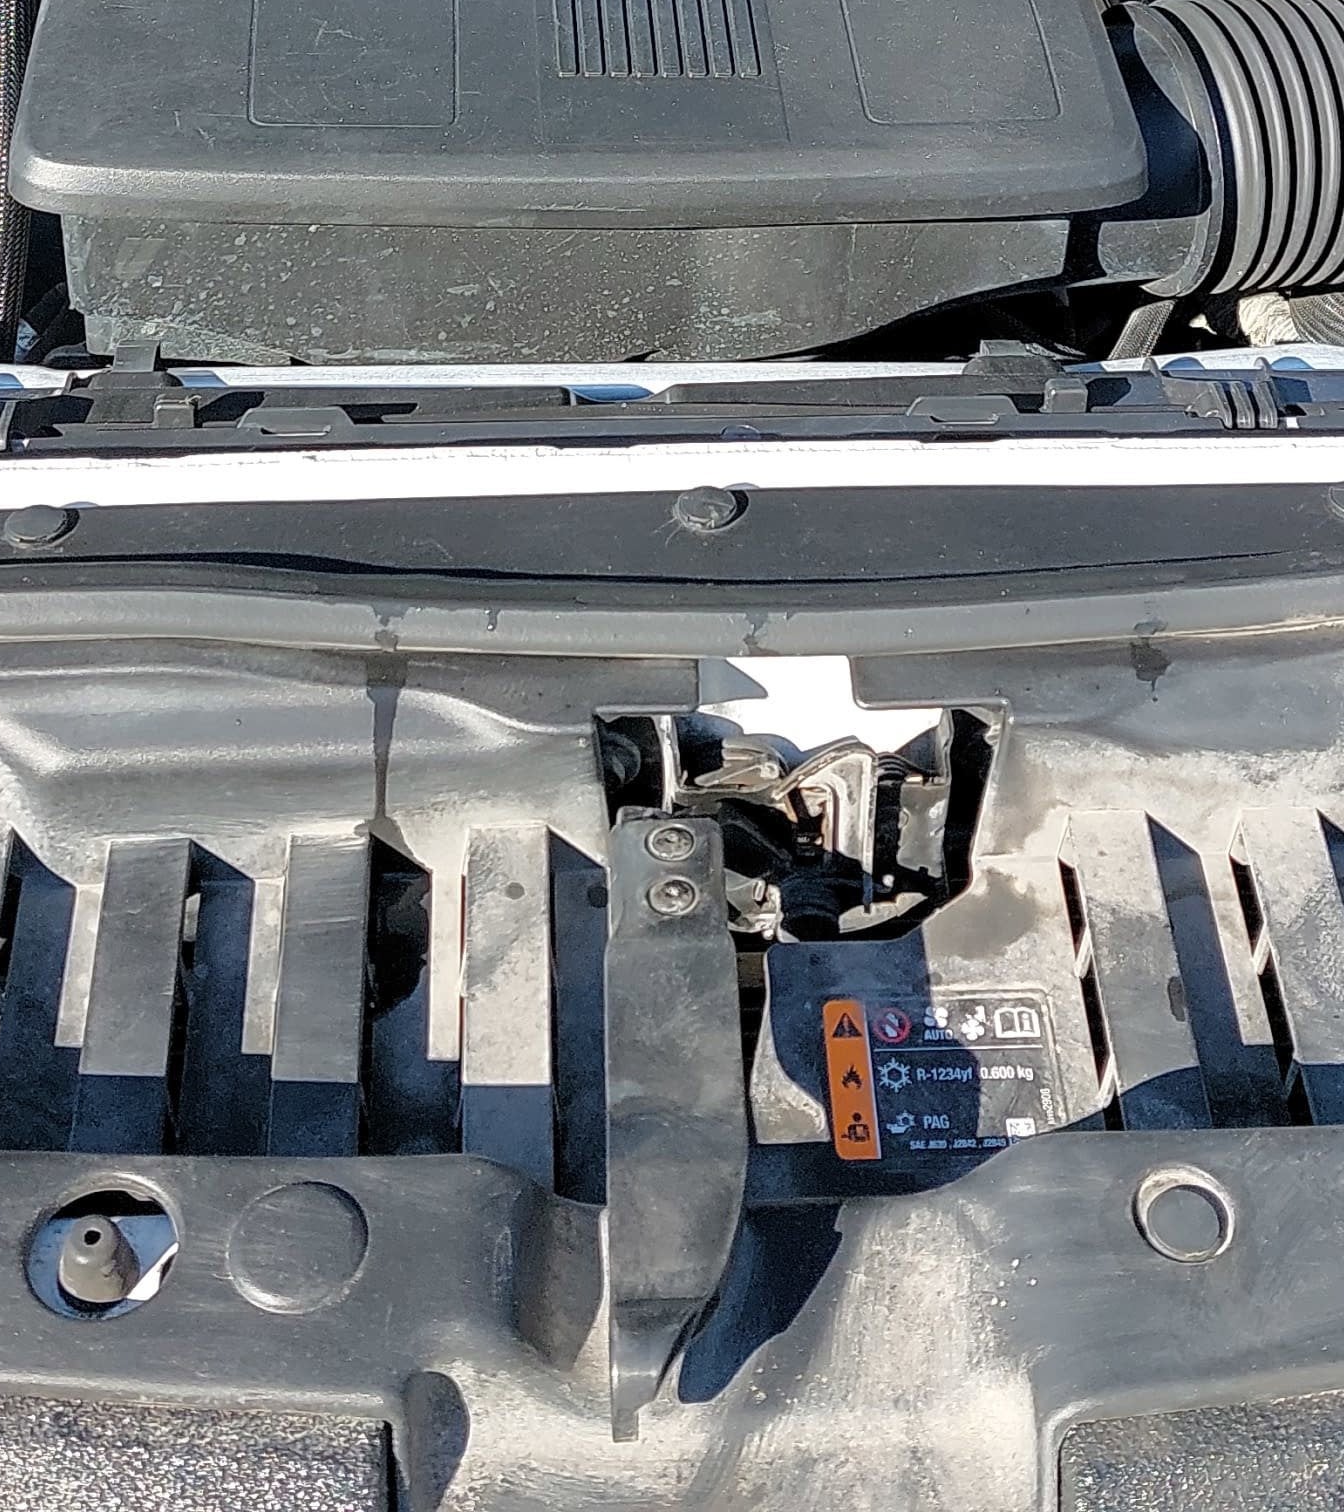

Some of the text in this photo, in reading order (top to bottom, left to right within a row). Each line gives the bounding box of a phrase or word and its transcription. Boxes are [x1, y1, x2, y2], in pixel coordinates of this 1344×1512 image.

[924, 1028, 954, 1040] AUTO
[916, 1065, 1034, 1083] R-1234yf 0.600 kg
[923, 1115, 950, 1129] PAG
[910, 1139, 926, 1150] SAE
